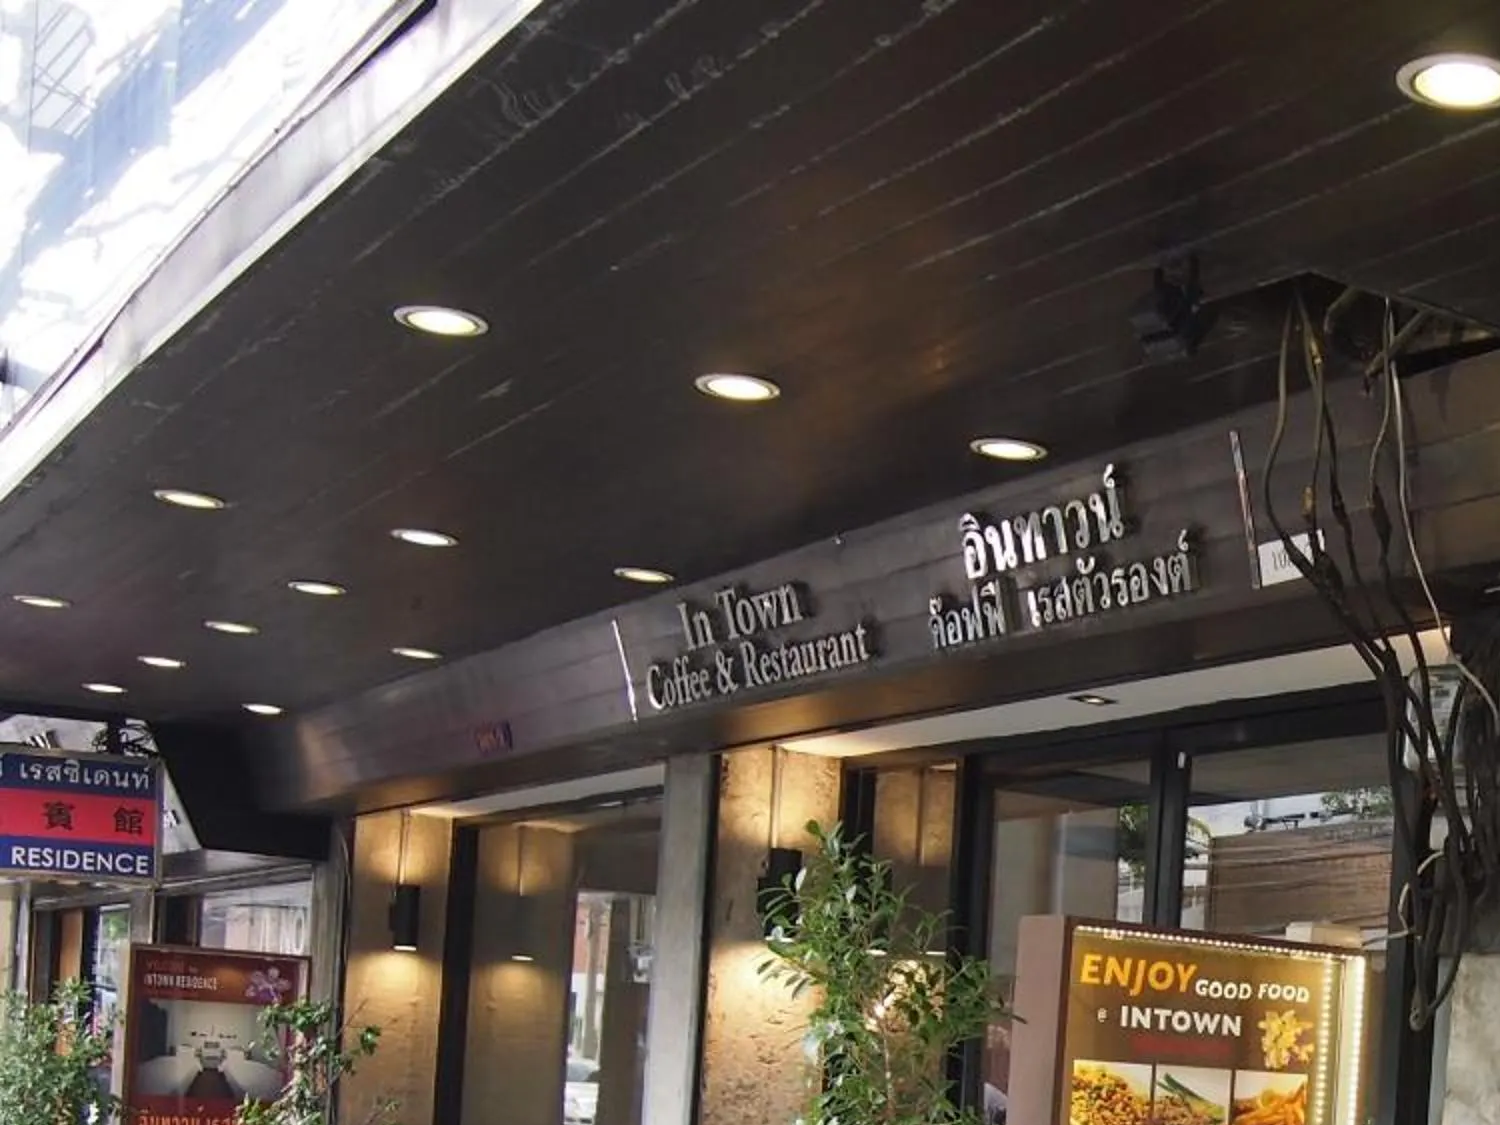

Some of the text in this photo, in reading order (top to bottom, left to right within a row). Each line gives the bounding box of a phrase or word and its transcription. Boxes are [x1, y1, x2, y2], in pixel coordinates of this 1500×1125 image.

[959, 463, 1124, 580] อินทาวน์
[676, 583, 803, 651] In Town
[647, 623, 870, 710] Coffee & Restaurant
[11, 846, 149, 875] RESIDENCE
[1079, 954, 1310, 1003] ENJOY GOOD FOOD
[1120, 1005, 1242, 1036] INTOWN
